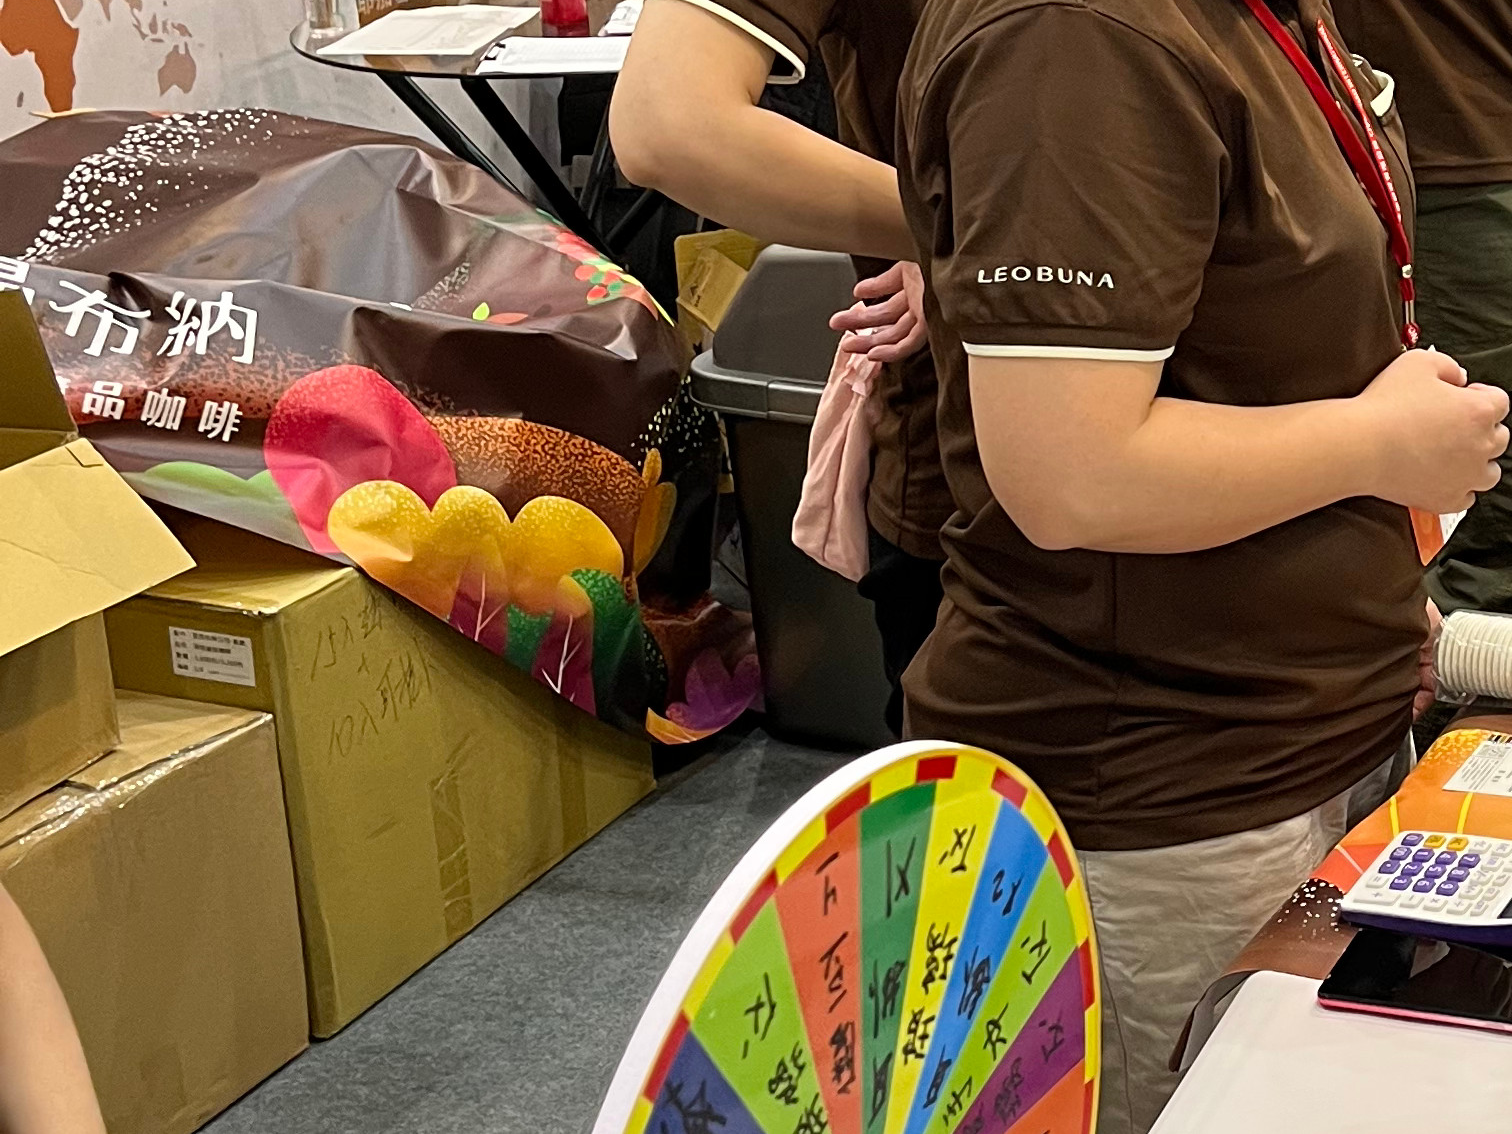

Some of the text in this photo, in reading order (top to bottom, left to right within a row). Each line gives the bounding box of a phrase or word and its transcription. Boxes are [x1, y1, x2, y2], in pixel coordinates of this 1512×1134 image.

[977, 266, 1115, 289] LEOBUNA
[55, 375, 243, 442] 品咖啡
